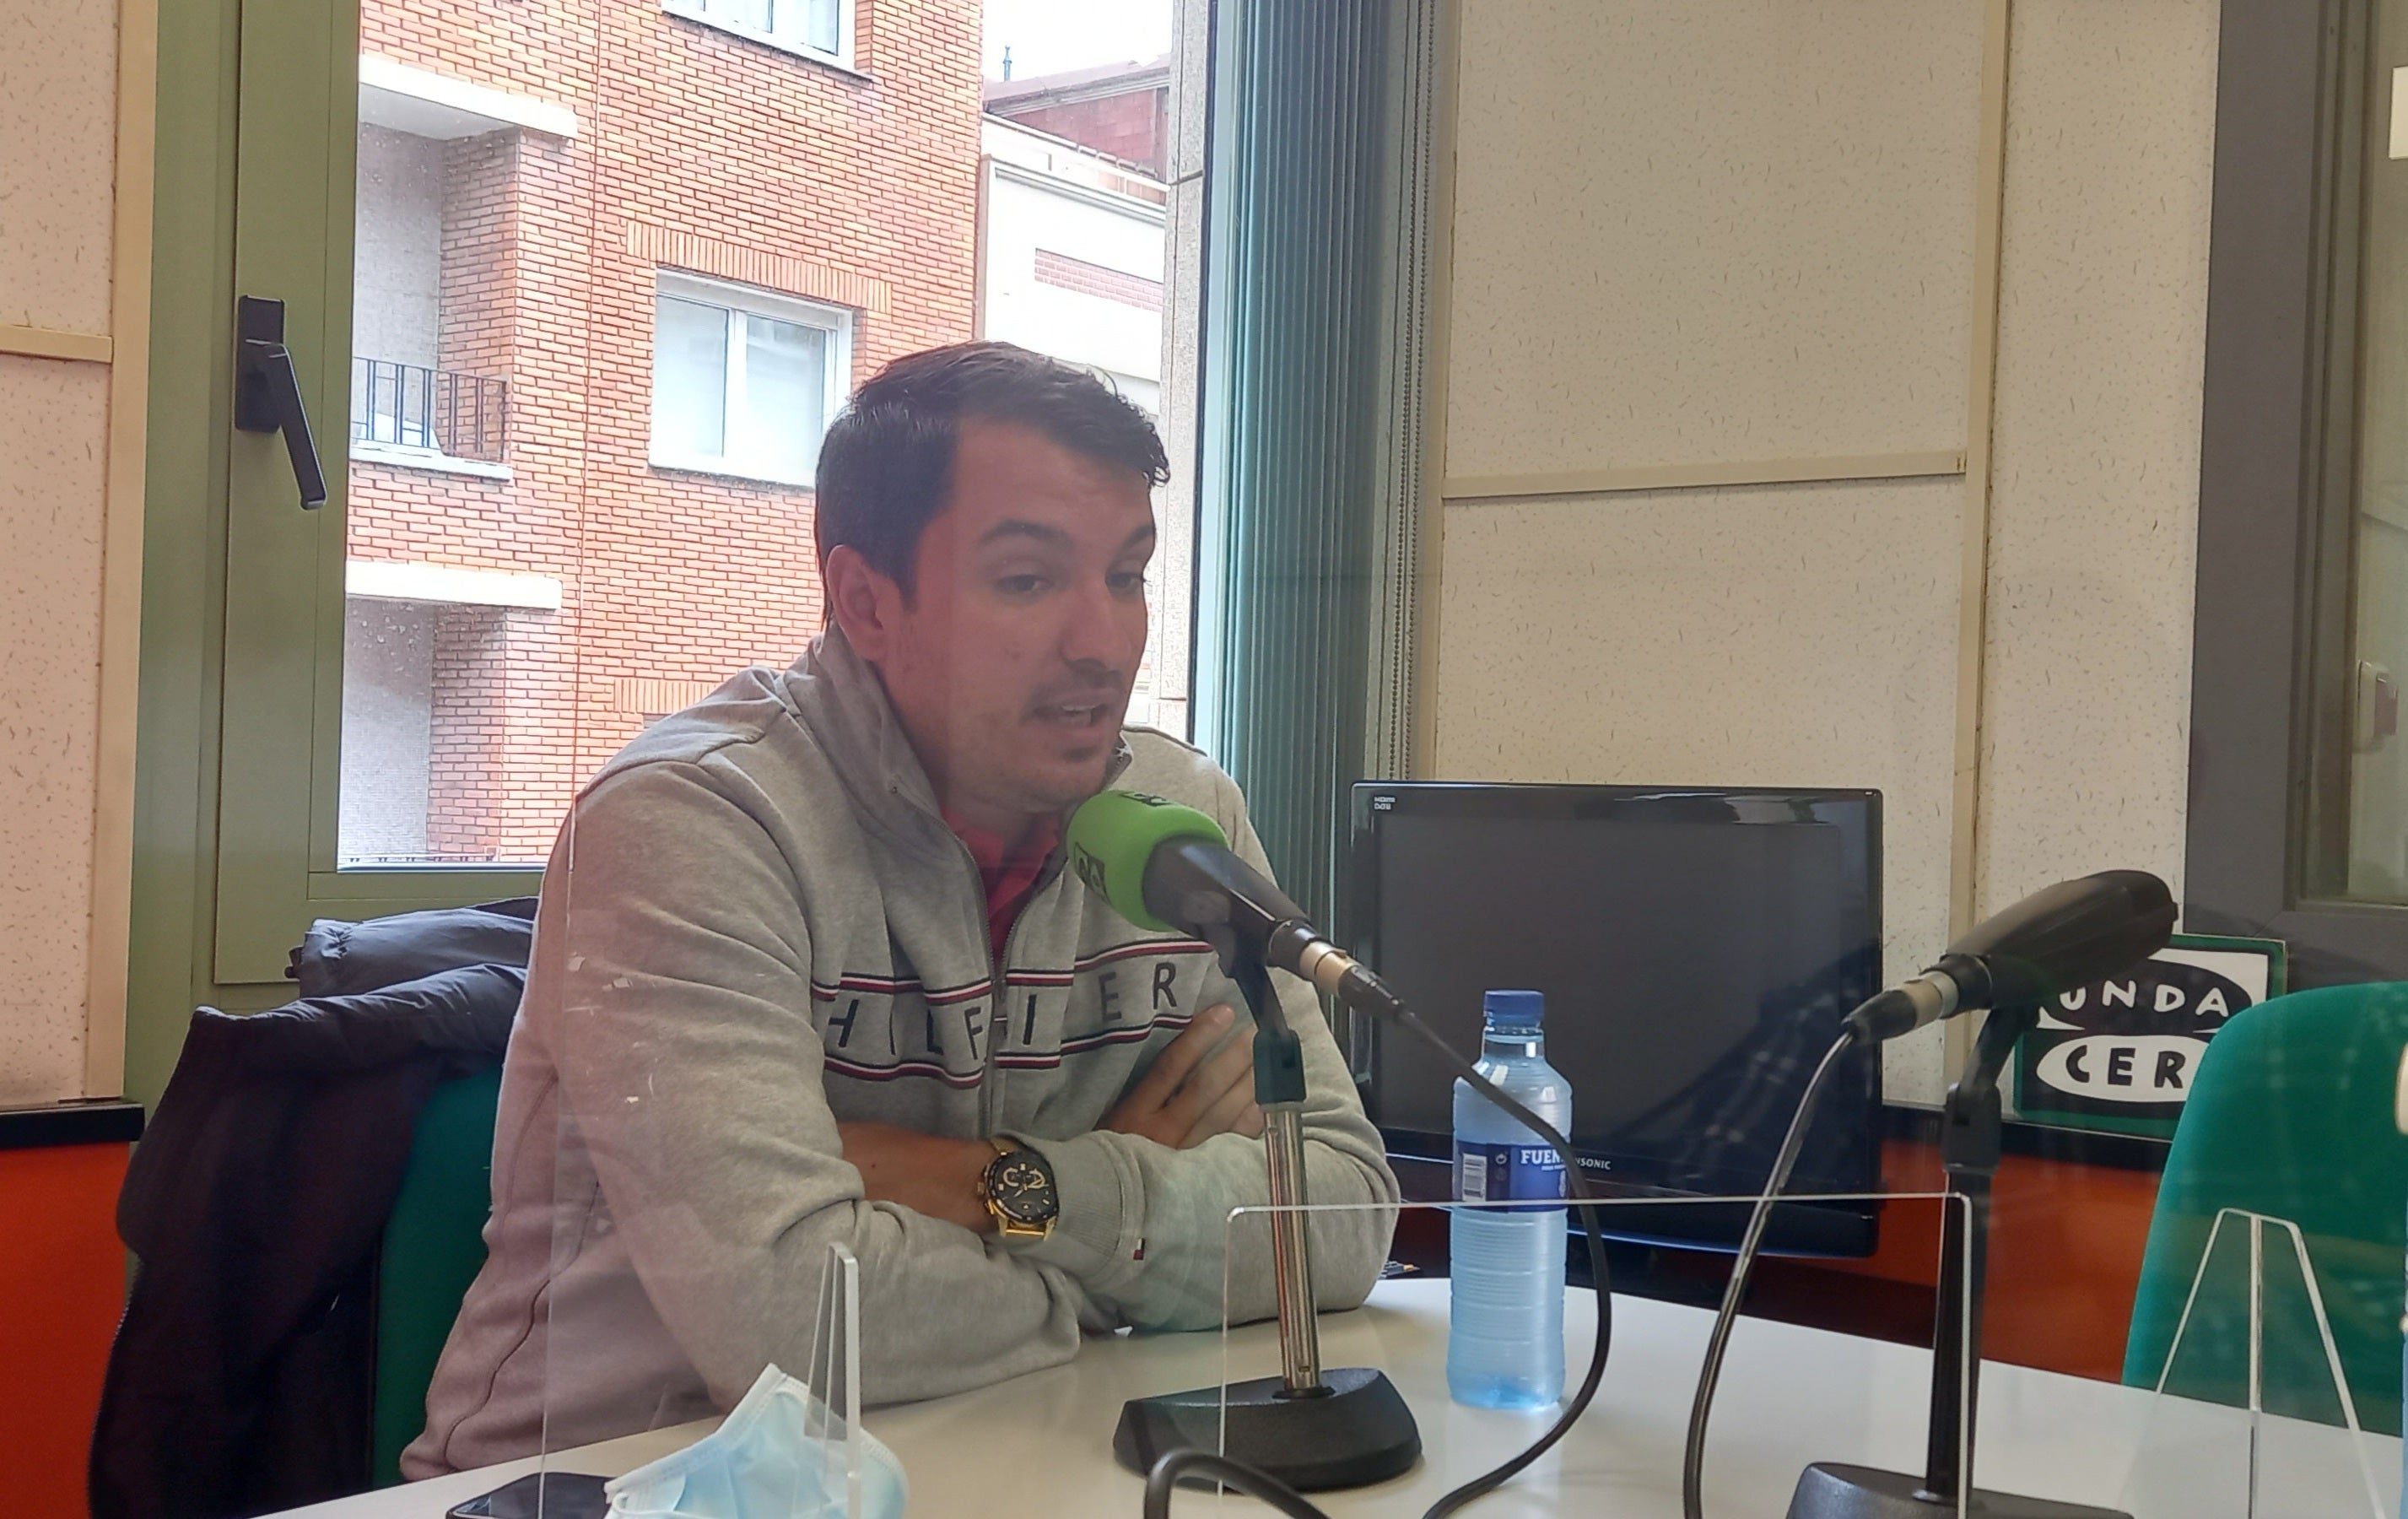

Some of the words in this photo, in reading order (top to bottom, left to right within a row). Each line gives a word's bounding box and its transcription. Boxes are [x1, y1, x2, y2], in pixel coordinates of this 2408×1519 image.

[828, 962, 1178, 1060] HILFIER
[2065, 1045, 2187, 1089] CER
[1520, 1149, 1564, 1165] FUEN
